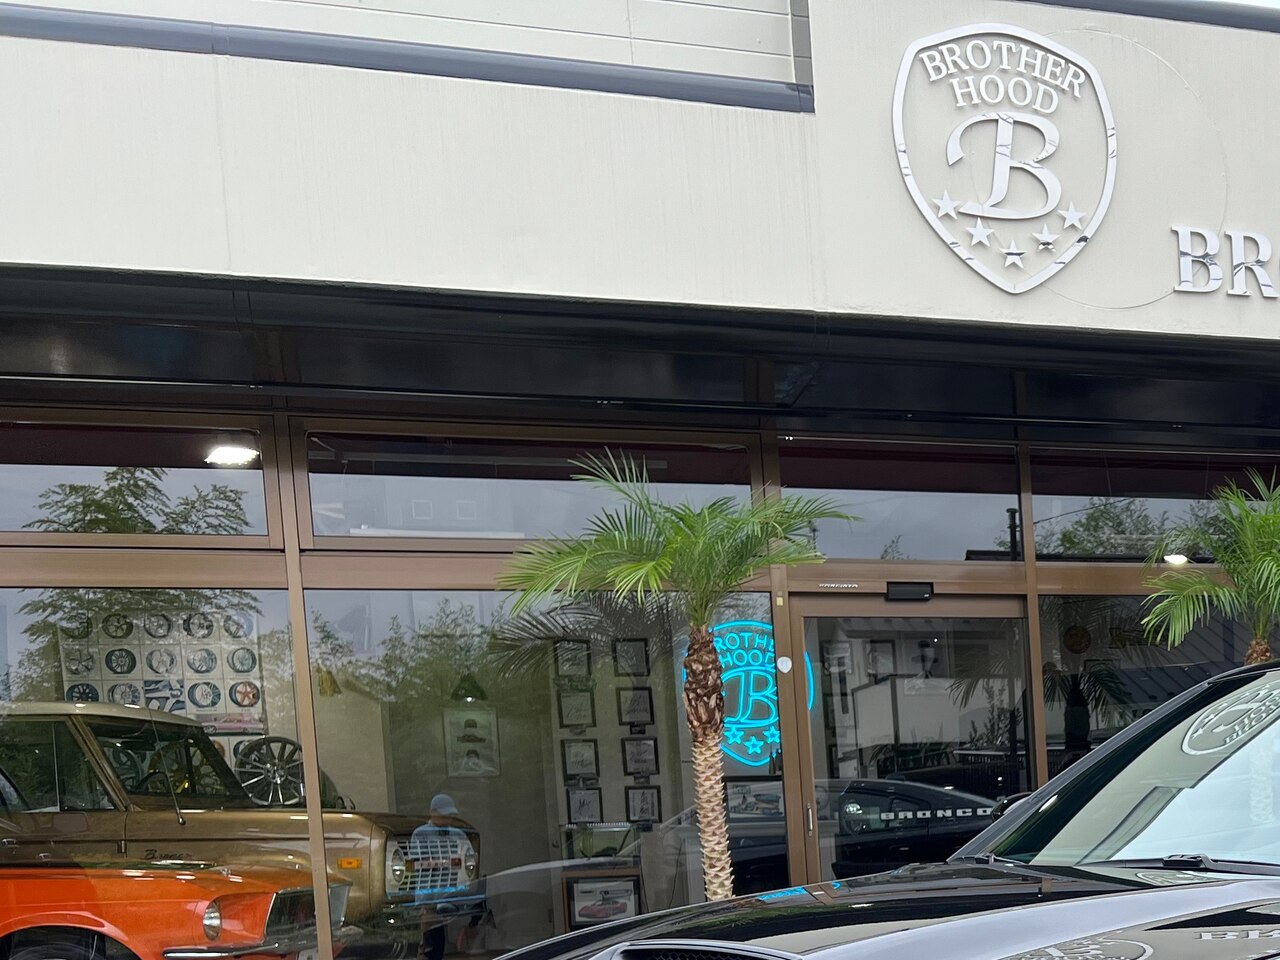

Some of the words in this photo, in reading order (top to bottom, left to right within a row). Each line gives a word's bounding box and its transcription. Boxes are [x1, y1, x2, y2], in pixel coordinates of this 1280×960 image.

[918, 39, 1087, 98] BROTHER
[949, 74, 1060, 115] HOOD
[946, 112, 1062, 219] B
[880, 807, 993, 821] BRONCO
